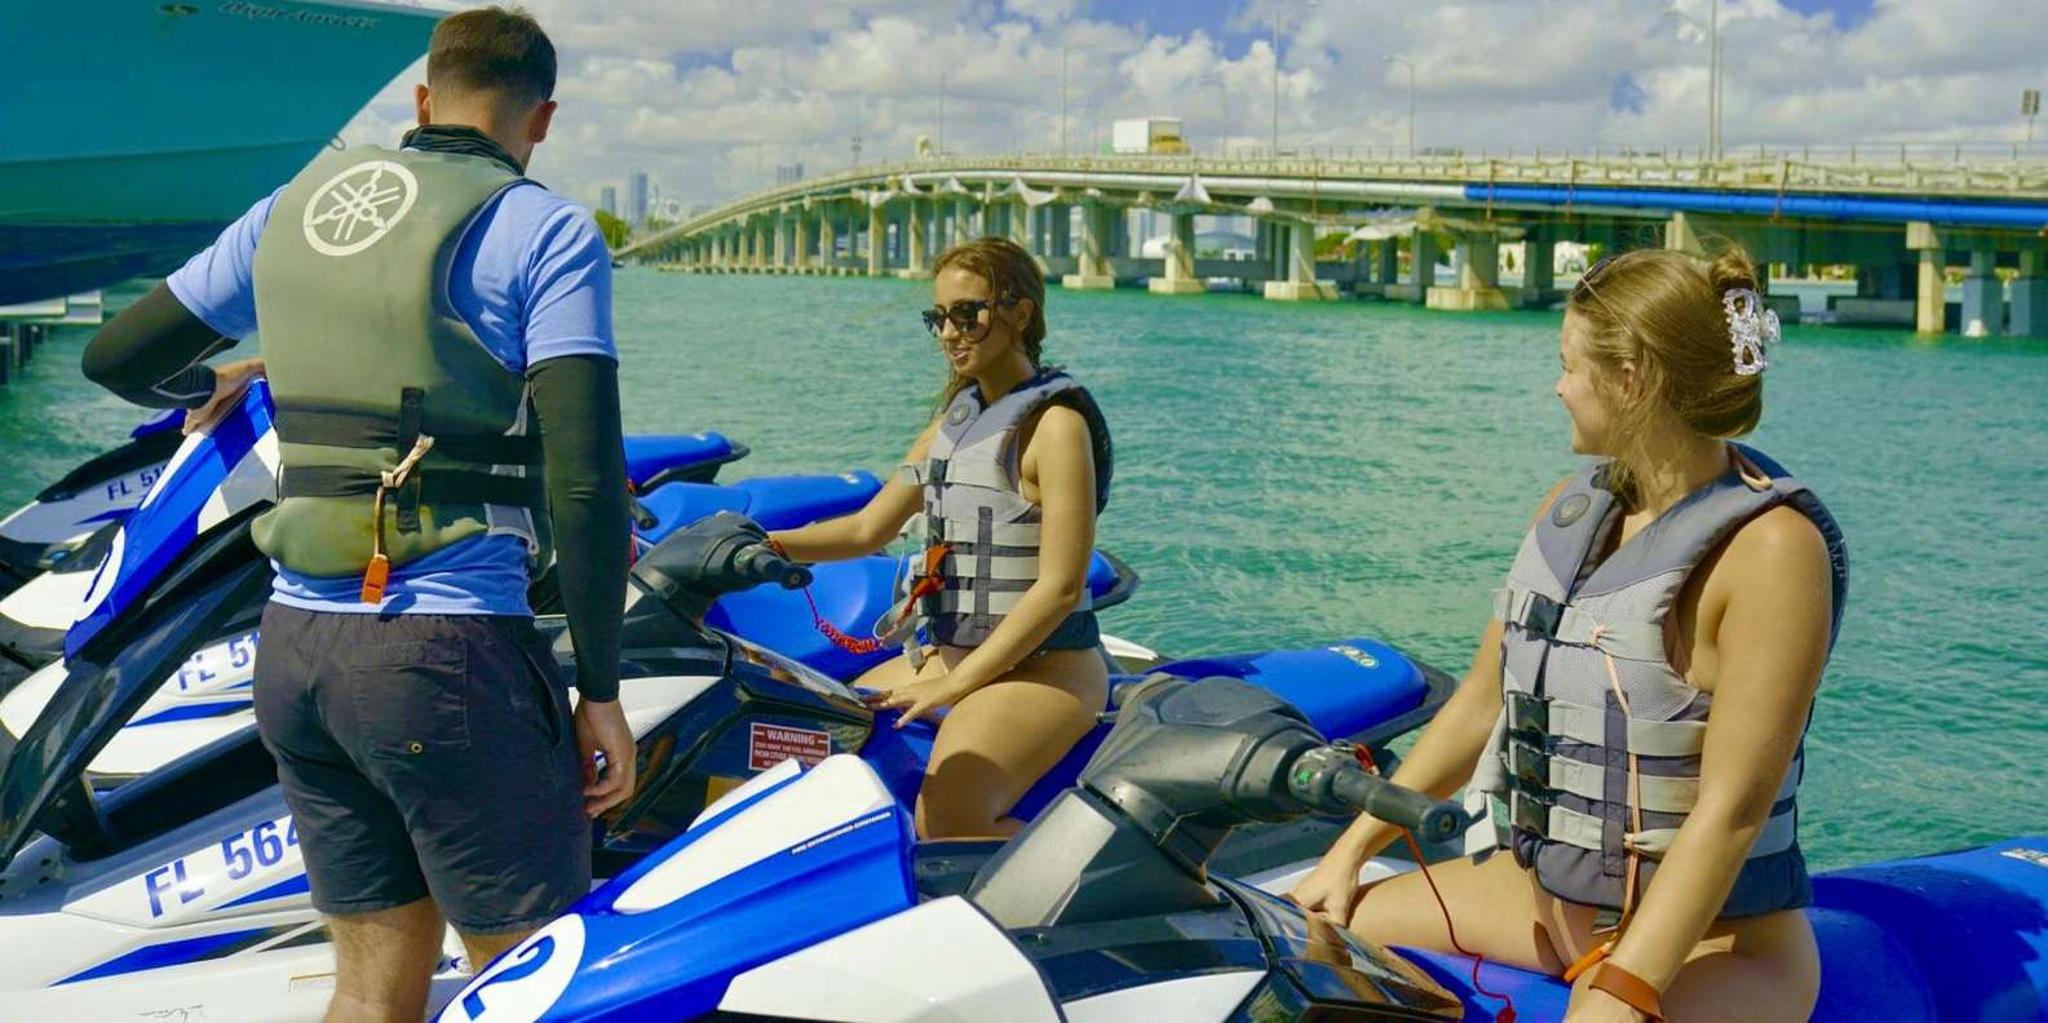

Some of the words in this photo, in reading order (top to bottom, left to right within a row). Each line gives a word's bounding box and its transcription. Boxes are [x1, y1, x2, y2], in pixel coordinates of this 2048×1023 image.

[107, 480, 132, 501] FL
[766, 729, 815, 746] WARNING
[145, 858, 205, 918] FL
[462, 934, 556, 1021] 2
